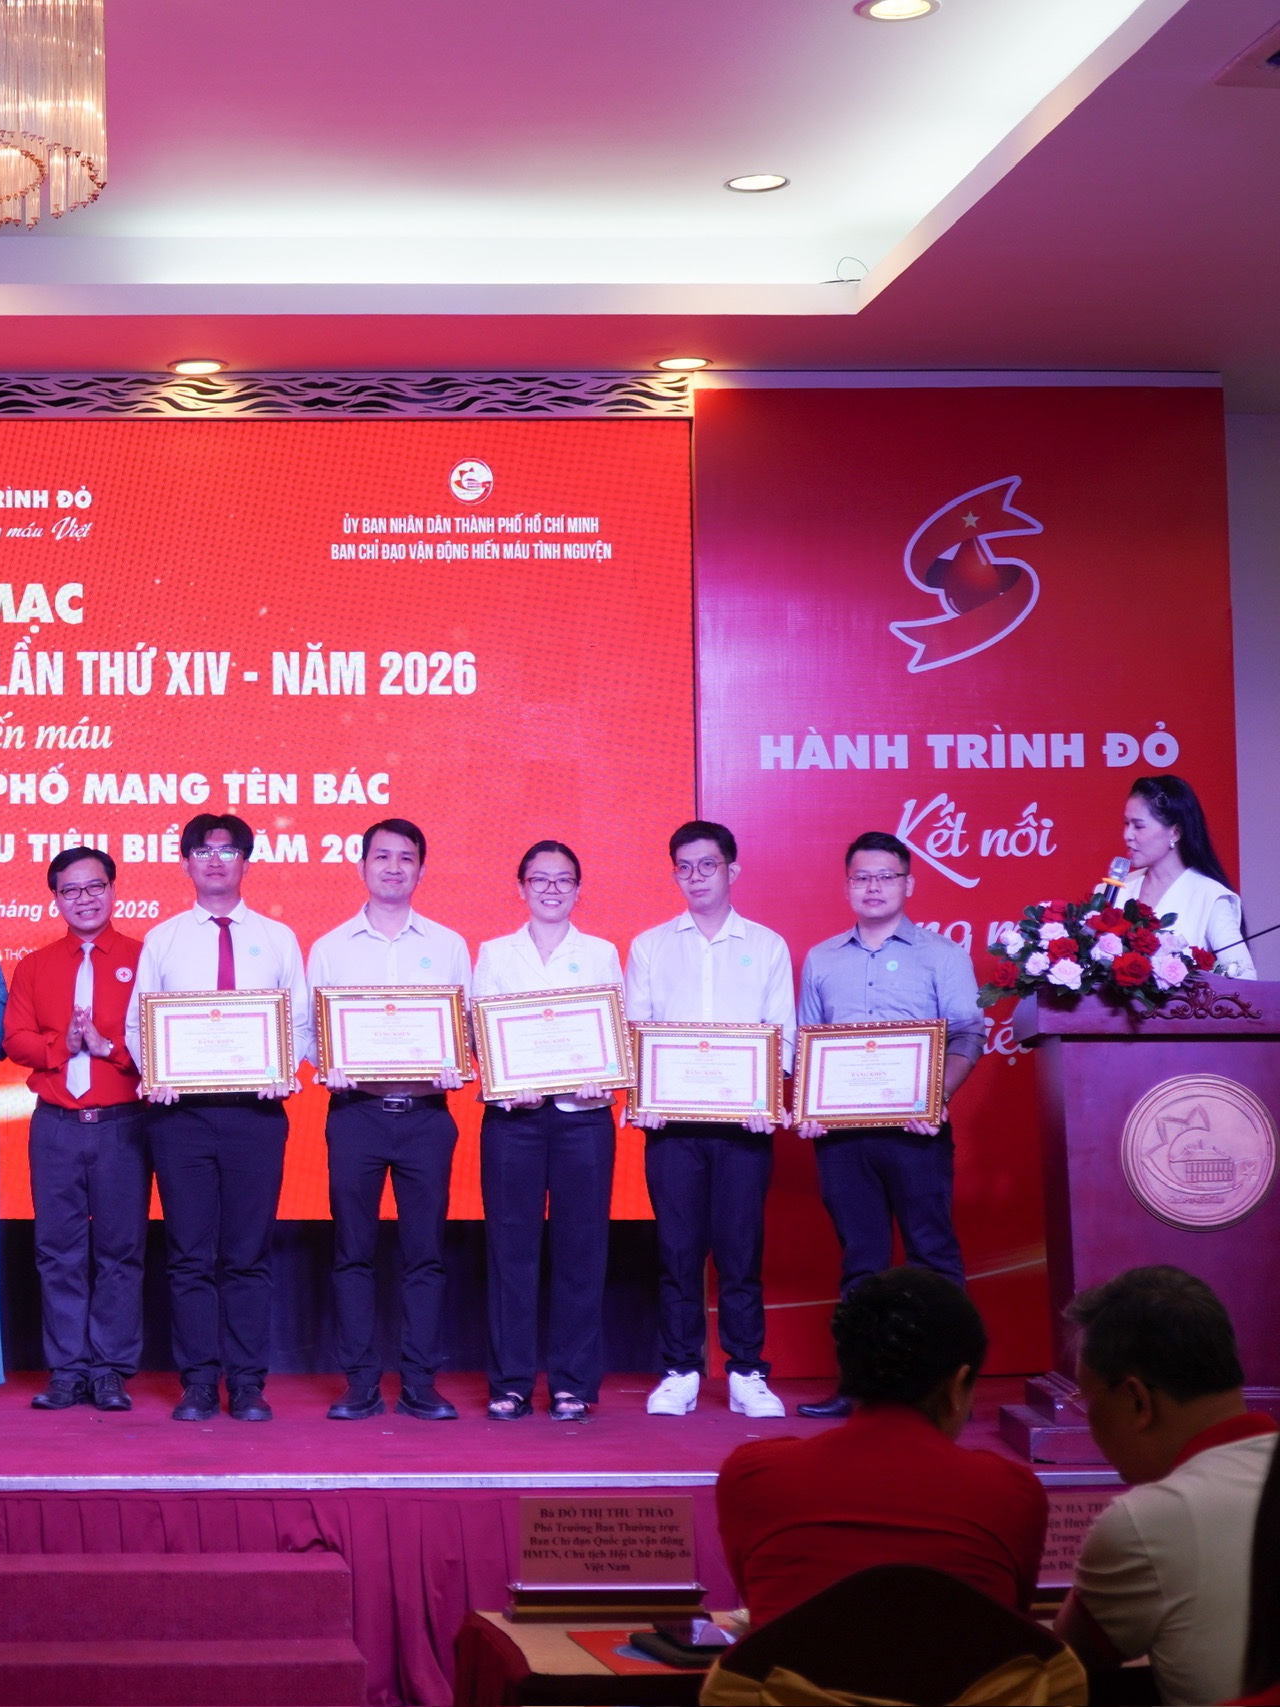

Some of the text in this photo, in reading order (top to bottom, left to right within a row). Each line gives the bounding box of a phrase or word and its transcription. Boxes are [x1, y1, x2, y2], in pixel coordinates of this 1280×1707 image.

[56, 485, 92, 509] ĐỎ
[6, 522, 43, 538] máu
[50, 516, 93, 542] Việt
[343, 512, 599, 534] ỦY BAN NHÂN DÂN THÀNH PHỐ HỒ CHÍ MINH
[331, 538, 612, 564] BAN CHỈ ĐẠO VẬN ĐỘNG HIẾN MÁU TÌNH NGUYỆN
[77, 642, 158, 696] THỨ
[166, 651, 236, 696] XIV
[243, 671, 259, 682] -
[272, 642, 366, 696] NĂM
[379, 651, 477, 696] 2026
[34, 715, 113, 750] máu
[760, 720, 1180, 770] HÀNH TRÌNH ĐỎ
[83, 772, 211, 805] MANG
[223, 767, 298, 805] TÊN
[313, 766, 390, 805] BÁC
[123, 824, 182, 863] BIỂ
[250, 829, 309, 863] ĂM
[321, 834, 364, 863] 20
[895, 793, 1057, 889] Kết nối
[48, 900, 60, 918] 6
[113, 900, 160, 919] 2026
[595, 1523, 614, 1532] Ban
[530, 1537, 549, 1546] Ban
[607, 1563, 630, 1572] Nam
